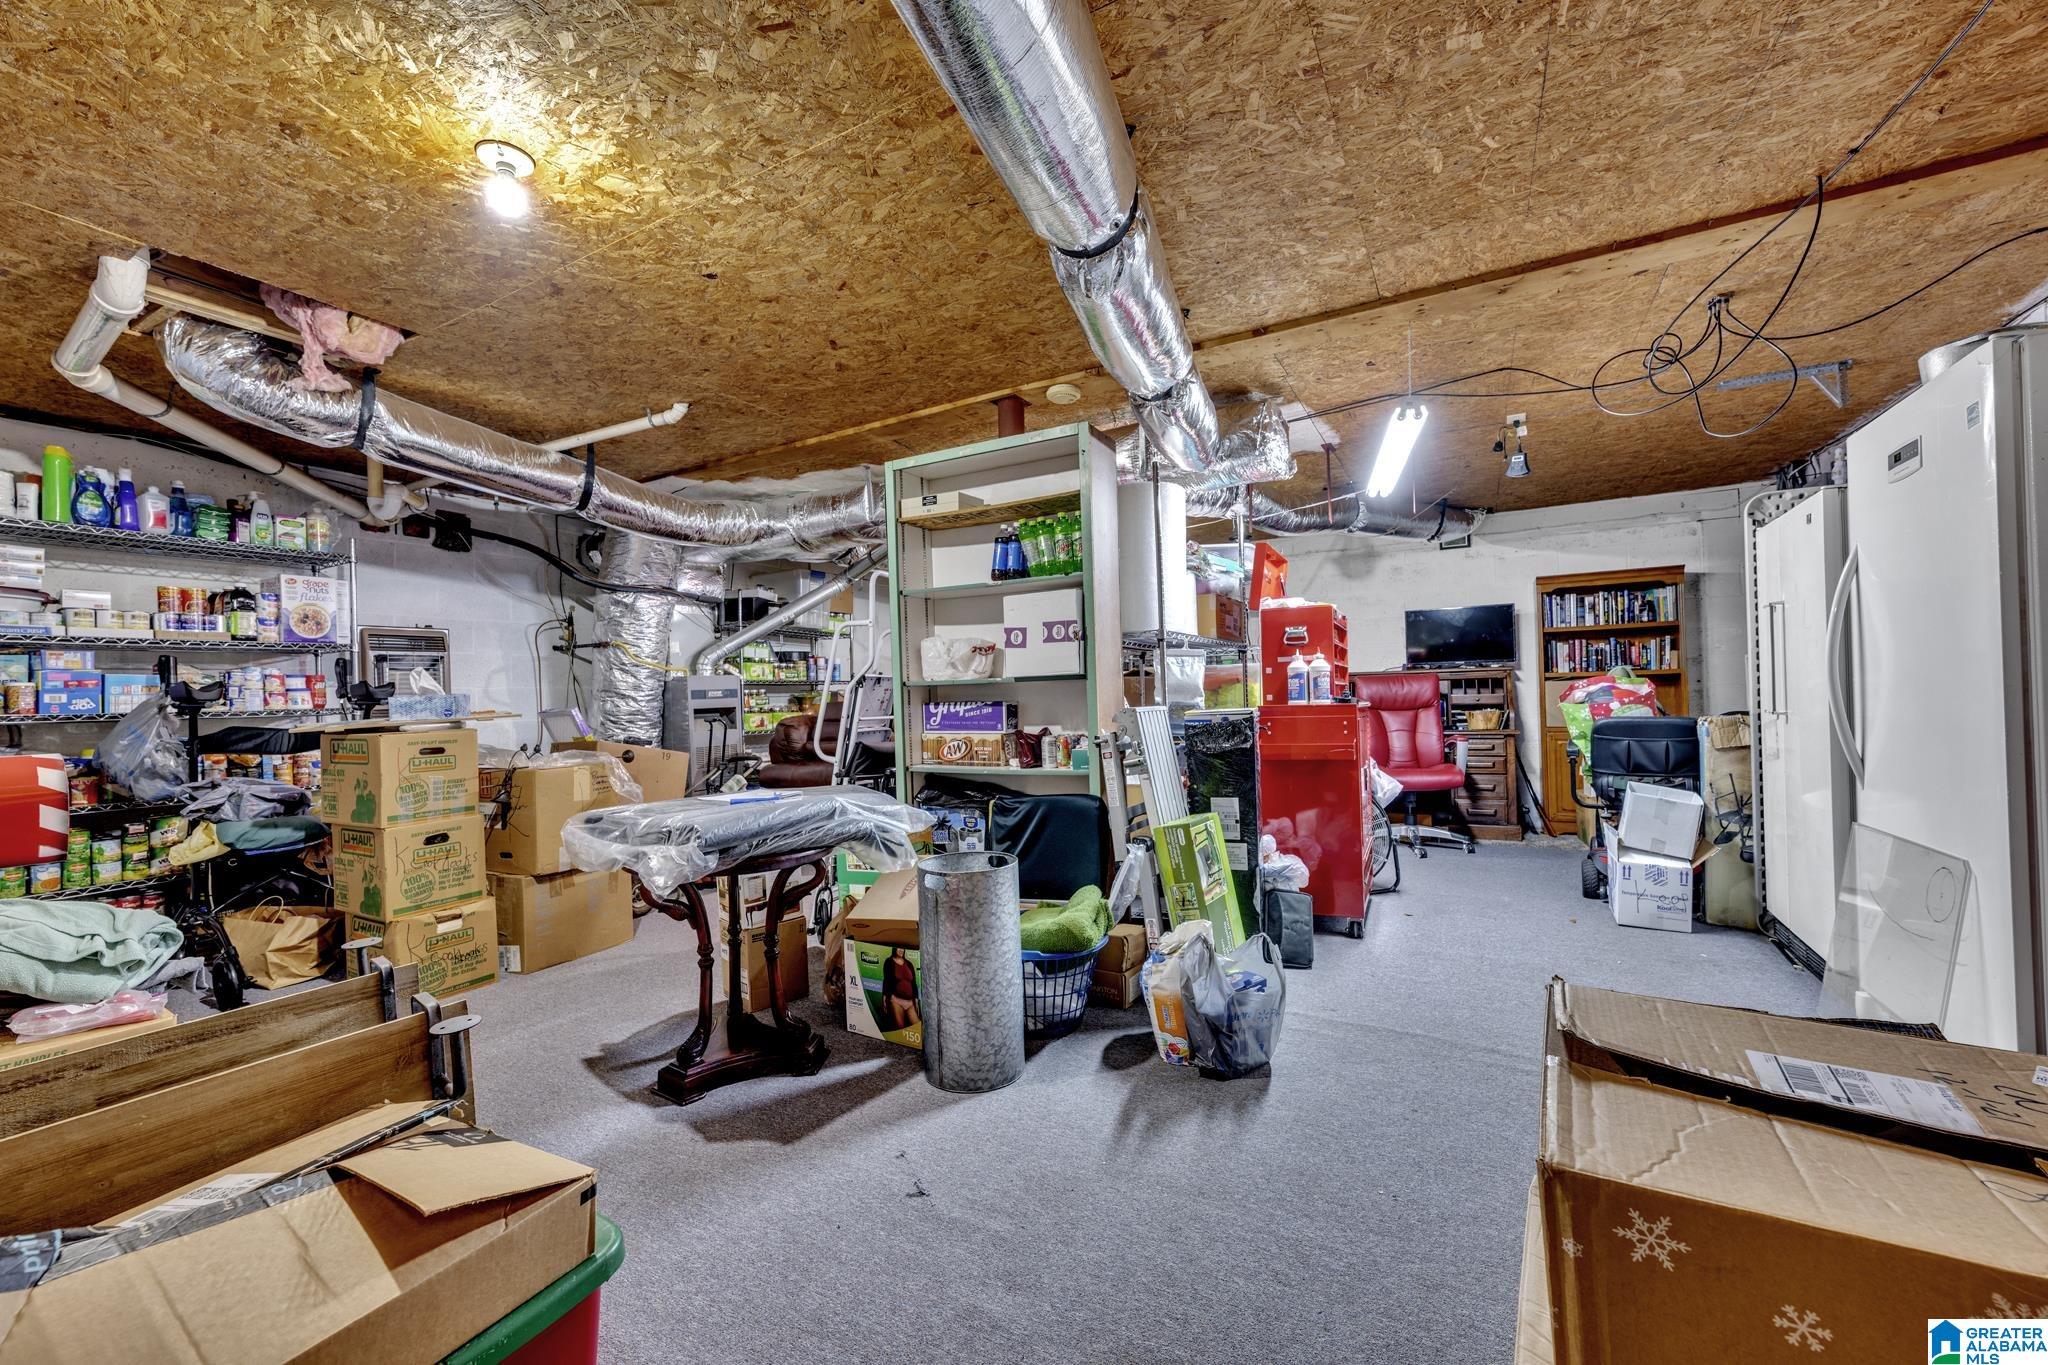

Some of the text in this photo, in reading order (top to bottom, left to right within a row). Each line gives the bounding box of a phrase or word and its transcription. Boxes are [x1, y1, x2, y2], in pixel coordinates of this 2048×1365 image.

[302, 579, 329, 588] grape
[332, 742, 367, 755] U-HAUL
[412, 757, 454, 767] U-HAUL
[662, 752, 671, 761] 19
[343, 833, 373, 847] U-HAUL
[416, 845, 459, 857] U-HAUL
[405, 871, 430, 887] 100%
[861, 953, 877, 962] Depend
[850, 975, 858, 987] XL
[849, 1023, 857, 1031] 80
